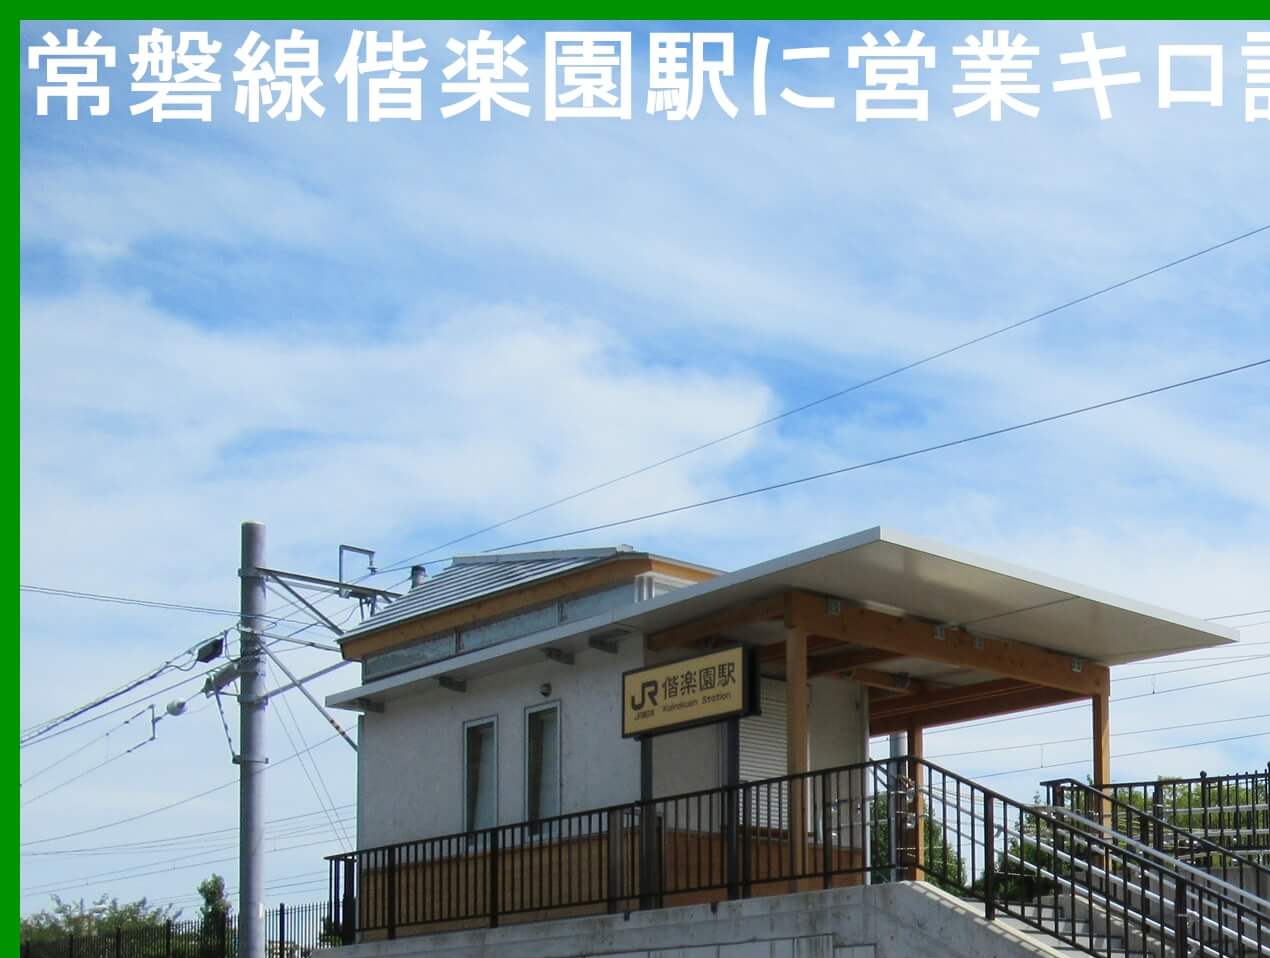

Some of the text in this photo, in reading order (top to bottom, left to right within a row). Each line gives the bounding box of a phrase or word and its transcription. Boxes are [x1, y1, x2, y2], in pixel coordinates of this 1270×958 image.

[631, 662, 736, 711] JR 偕楽園駅
[702, 691, 732, 705] Station
